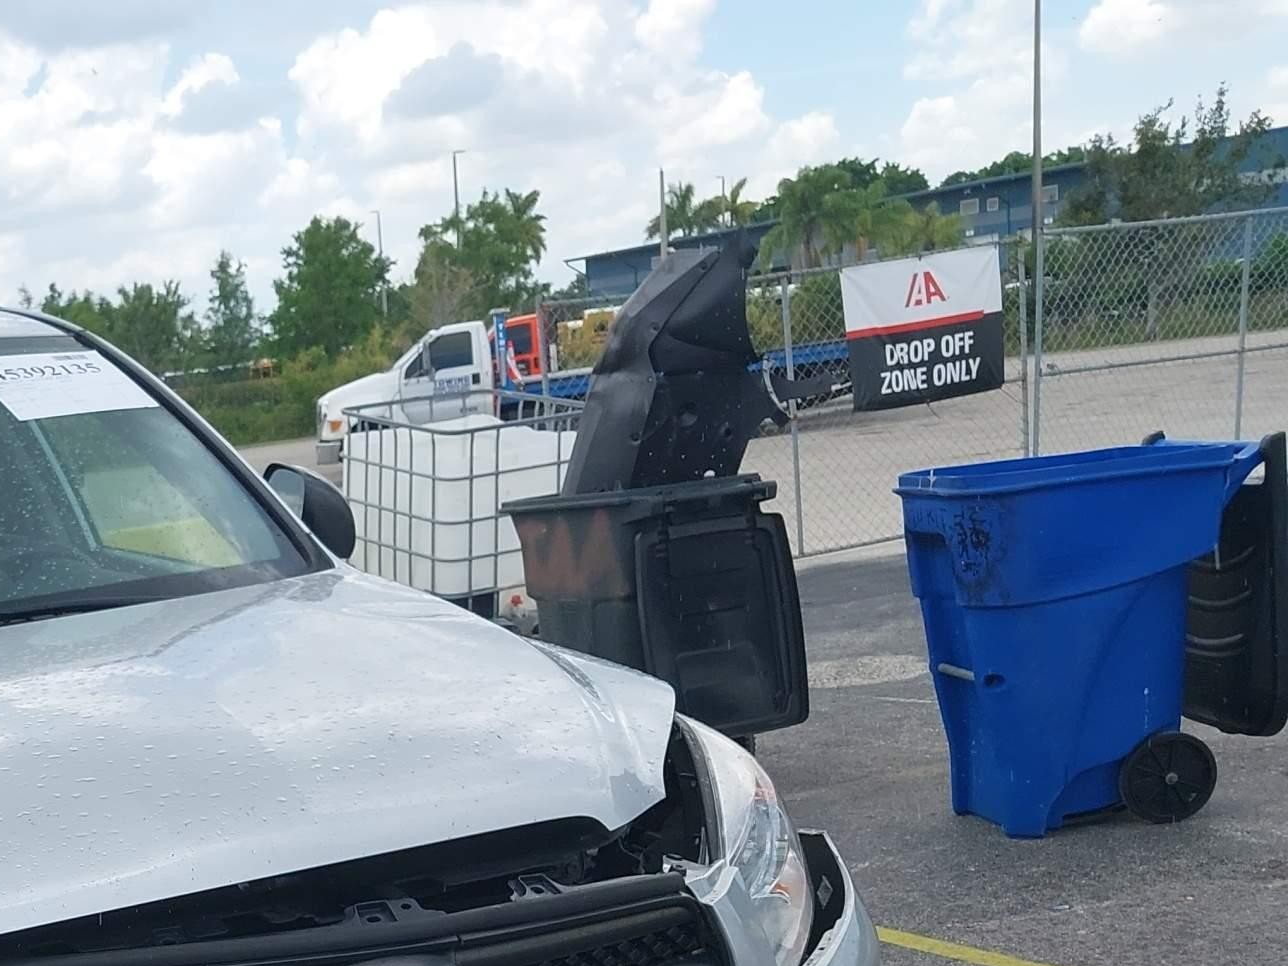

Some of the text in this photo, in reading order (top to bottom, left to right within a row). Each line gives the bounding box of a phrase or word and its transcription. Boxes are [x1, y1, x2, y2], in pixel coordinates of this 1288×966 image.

[885, 331, 974, 366] DROP OFF
[880, 357, 981, 395] ZONE ONLY
